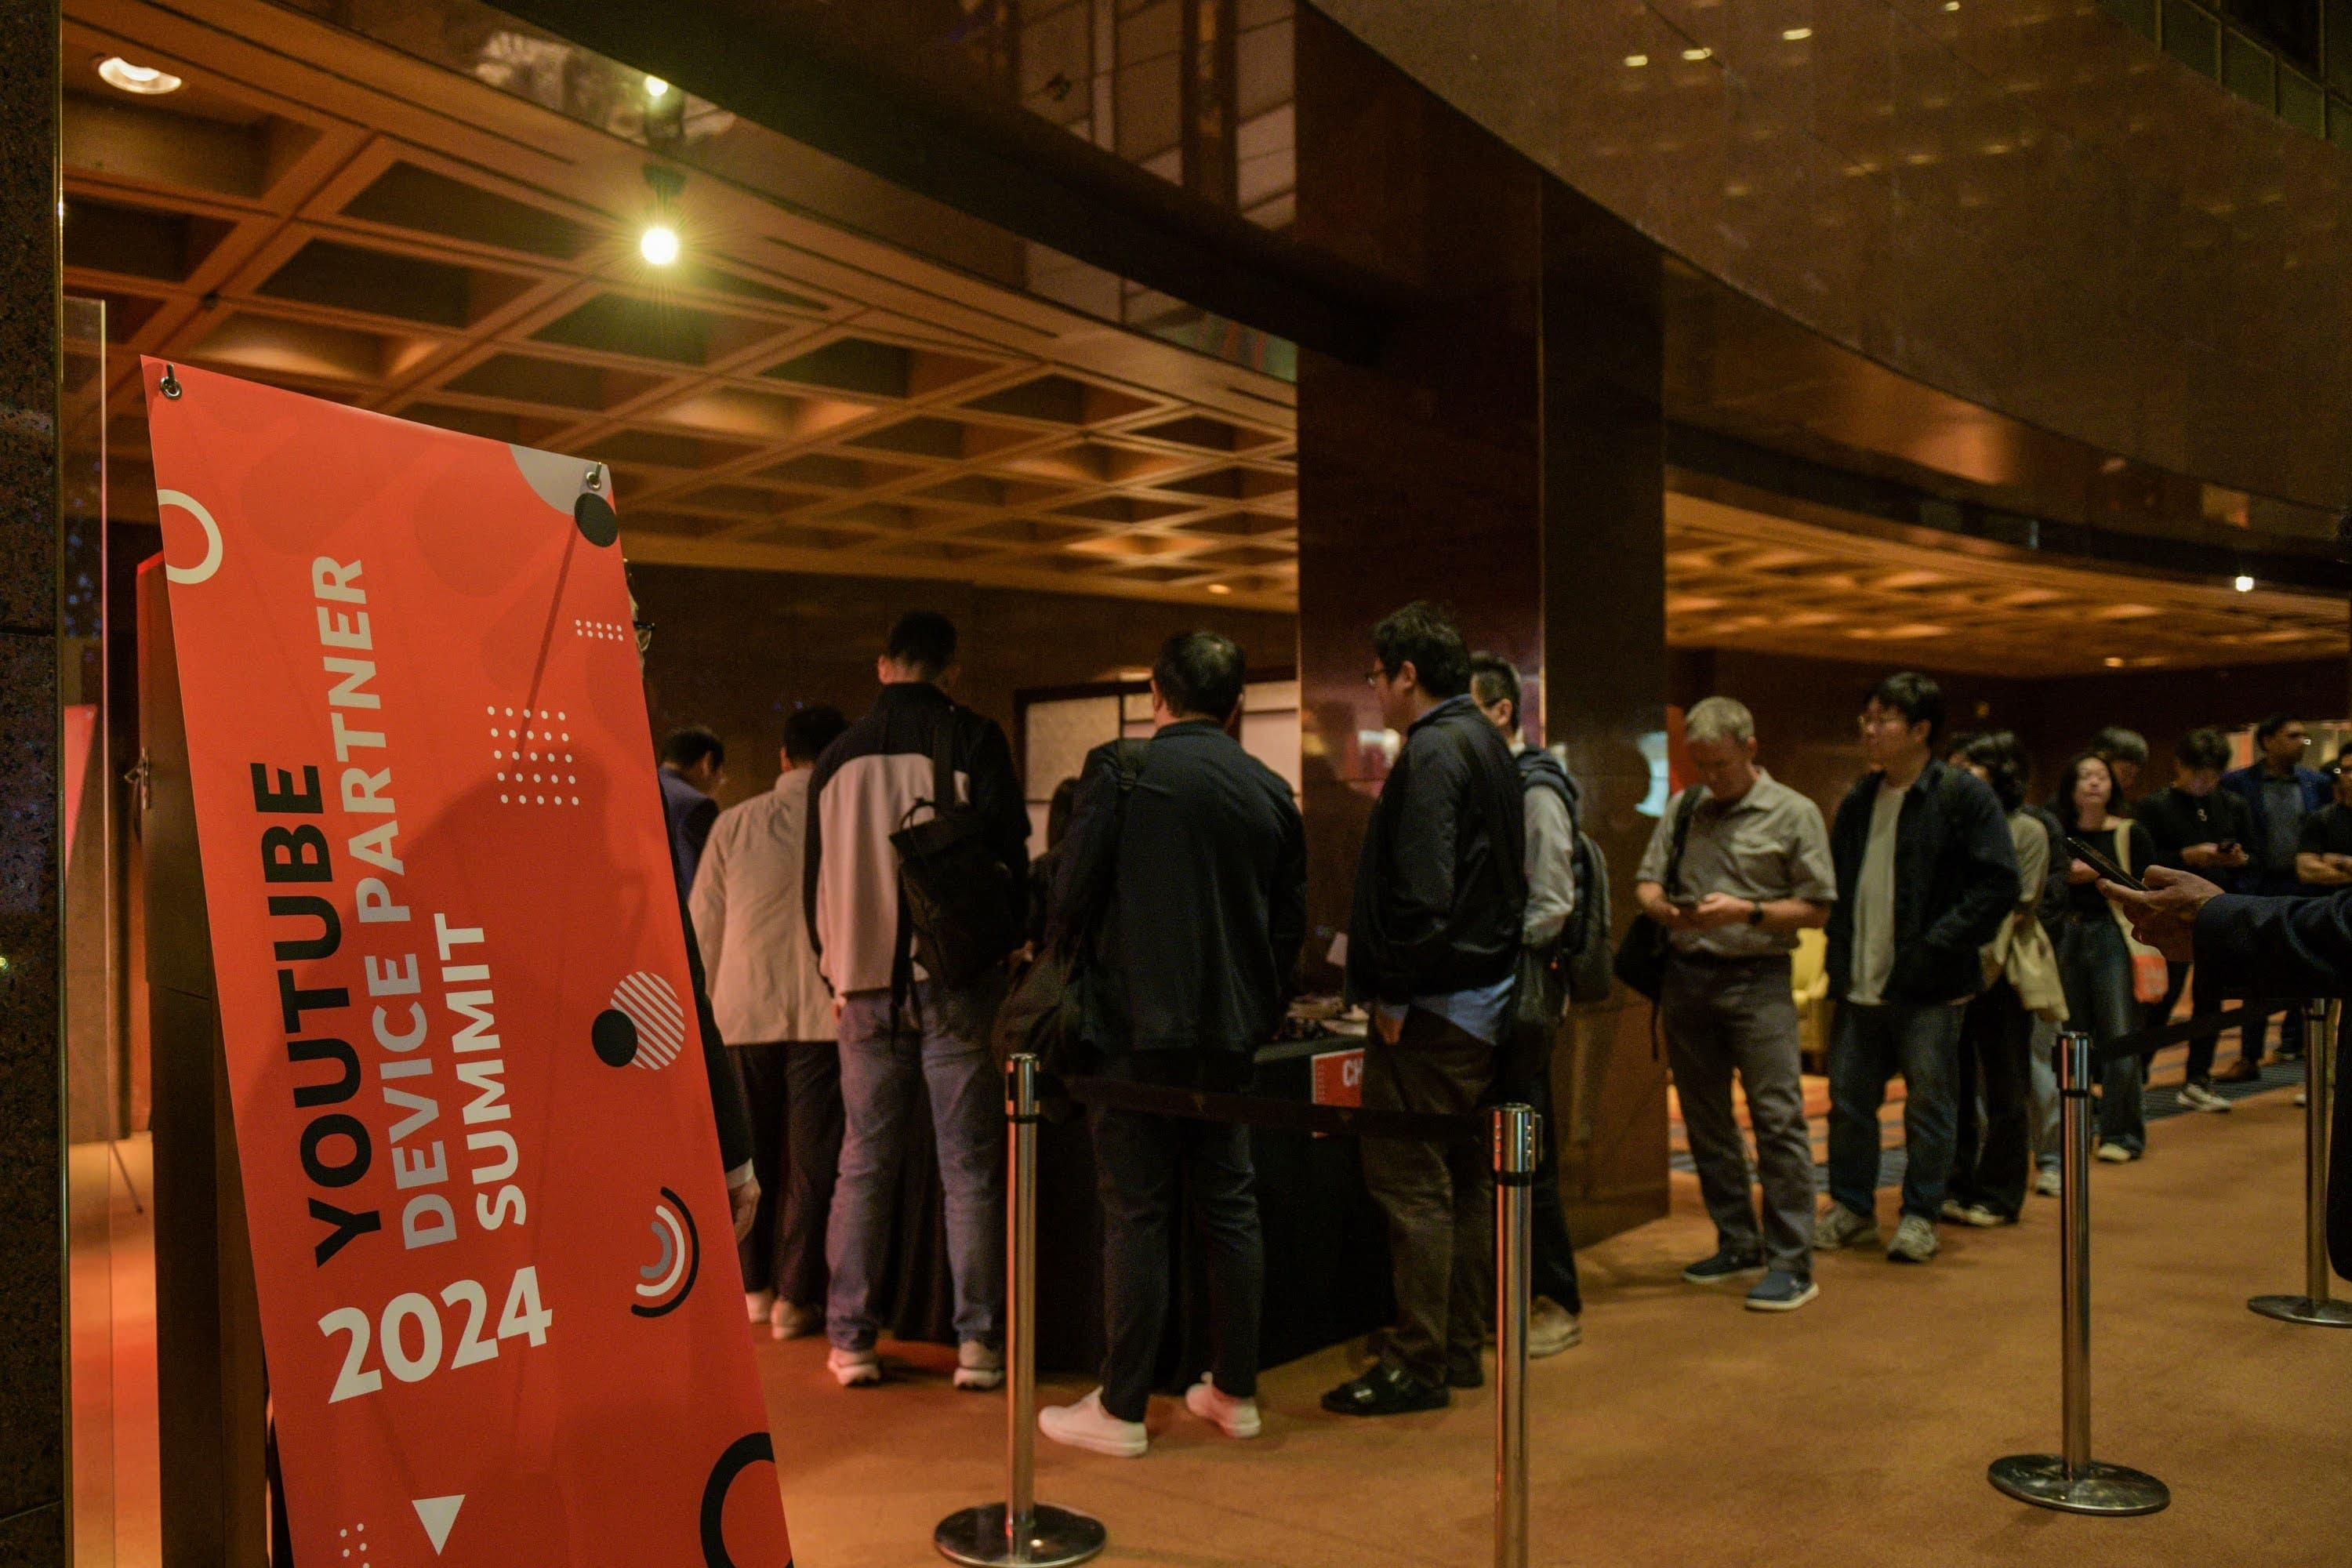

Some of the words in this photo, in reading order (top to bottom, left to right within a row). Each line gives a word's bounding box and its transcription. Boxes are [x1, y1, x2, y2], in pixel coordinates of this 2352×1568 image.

[311, 556, 410, 923] PARTNER
[251, 762, 380, 1267] YOUTUBE
[365, 953, 457, 1250] DEVICE
[434, 913, 526, 1231] SUMMIT
[318, 1266, 553, 1404] 2024
